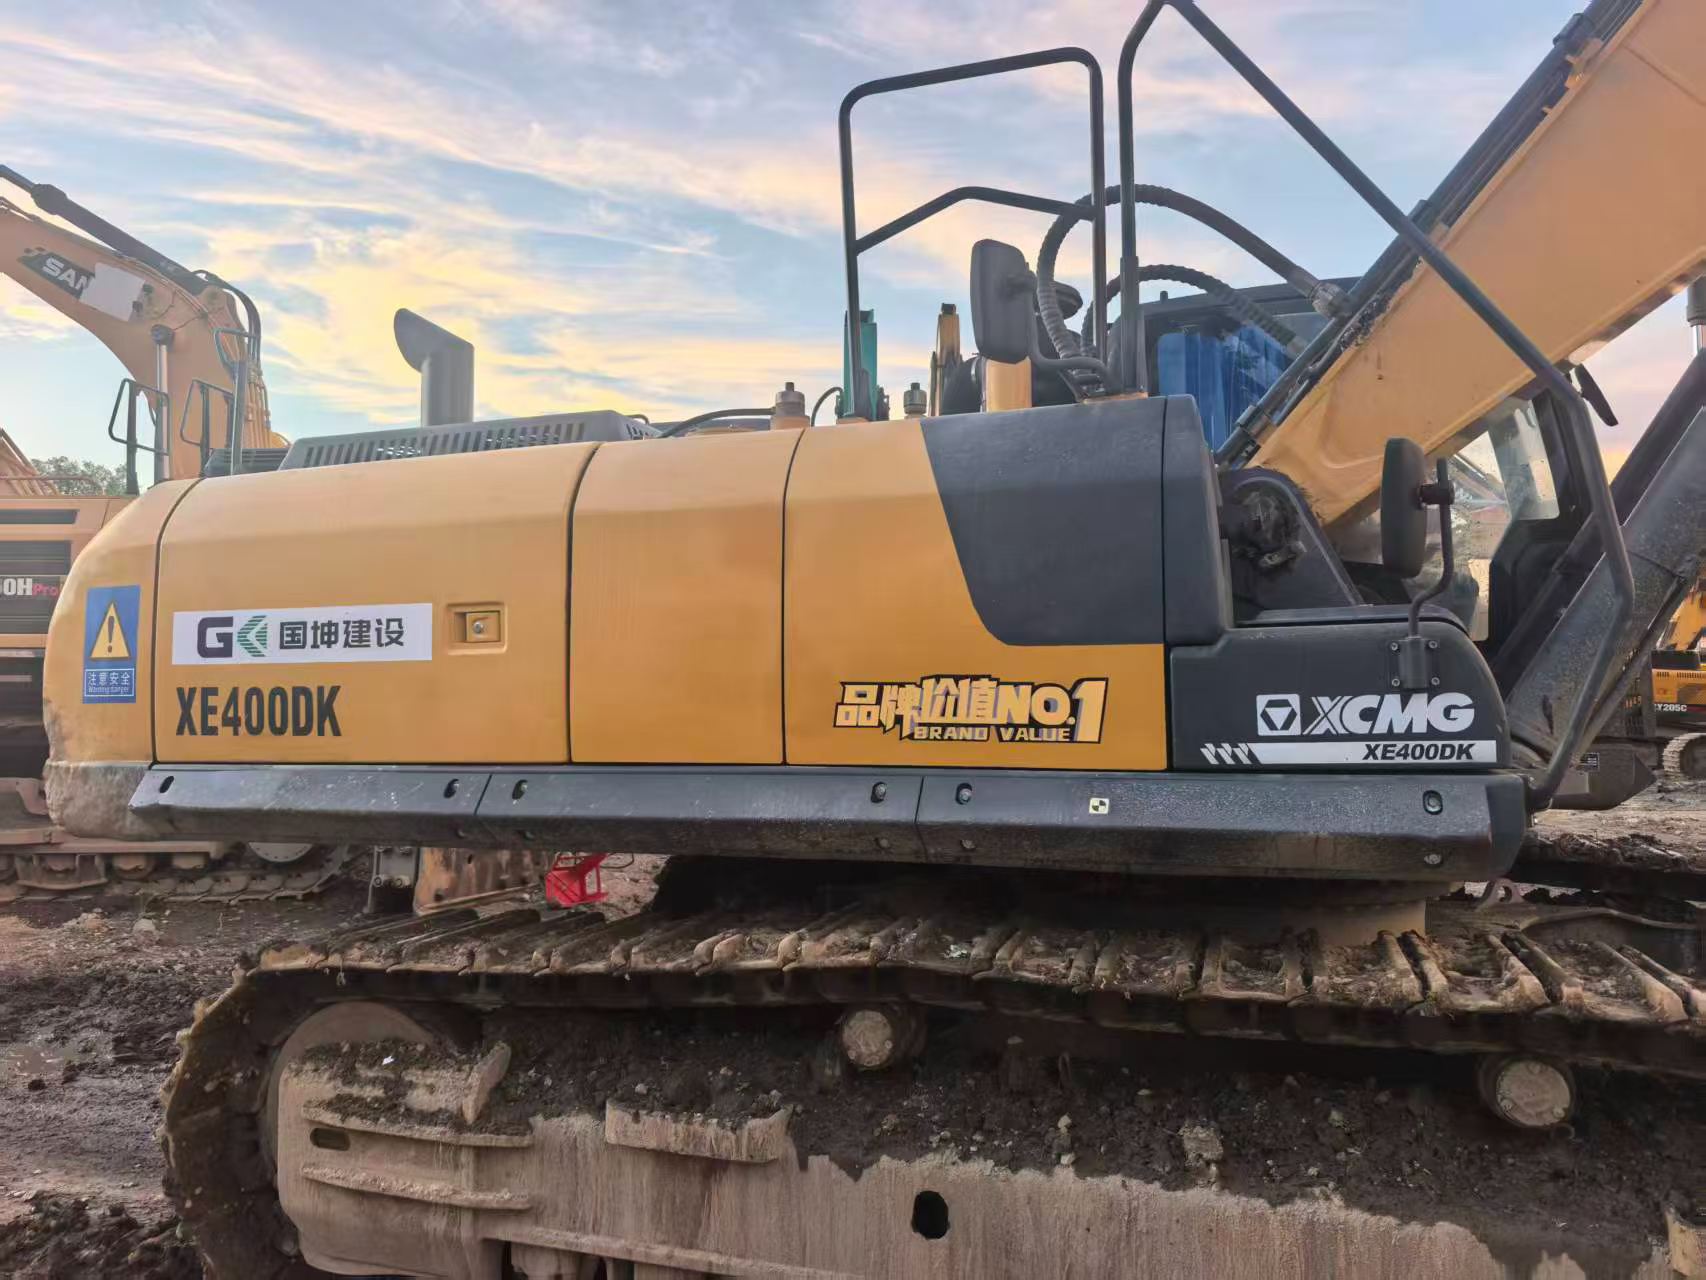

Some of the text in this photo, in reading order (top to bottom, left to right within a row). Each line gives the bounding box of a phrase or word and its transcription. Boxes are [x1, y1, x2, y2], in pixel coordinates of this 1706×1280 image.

[0, 578, 32, 595] 0H
[279, 617, 405, 650] 国坤建设
[88, 671, 130, 686] 注意安全
[175, 685, 342, 736] XE400DK
[1302, 692, 1475, 735] XCMG
[913, 726, 1072, 742] BRAND VALUE
[1362, 743, 1476, 760] XE400DK
